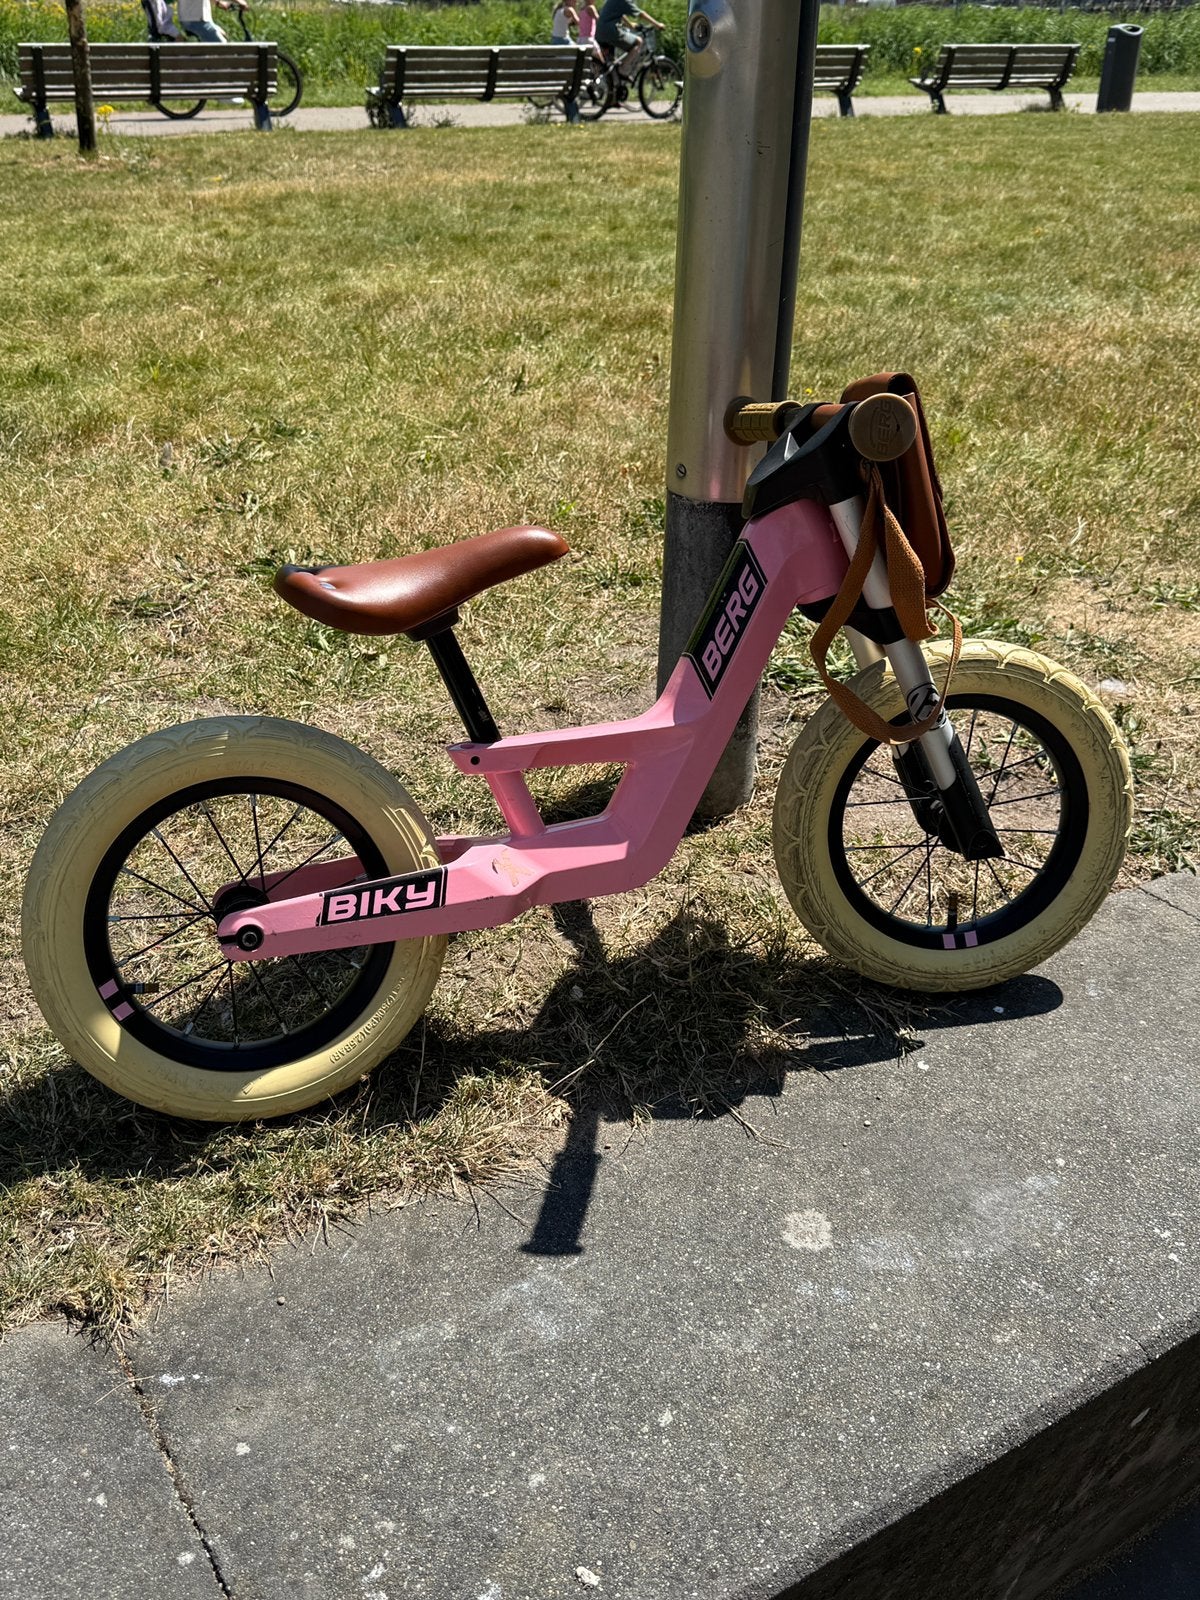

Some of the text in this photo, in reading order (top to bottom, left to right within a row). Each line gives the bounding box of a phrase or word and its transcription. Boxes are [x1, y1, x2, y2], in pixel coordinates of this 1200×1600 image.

[877, 399, 892, 455] BERG
[701, 563, 759, 682] BERG
[327, 881, 436, 922] BIKY
